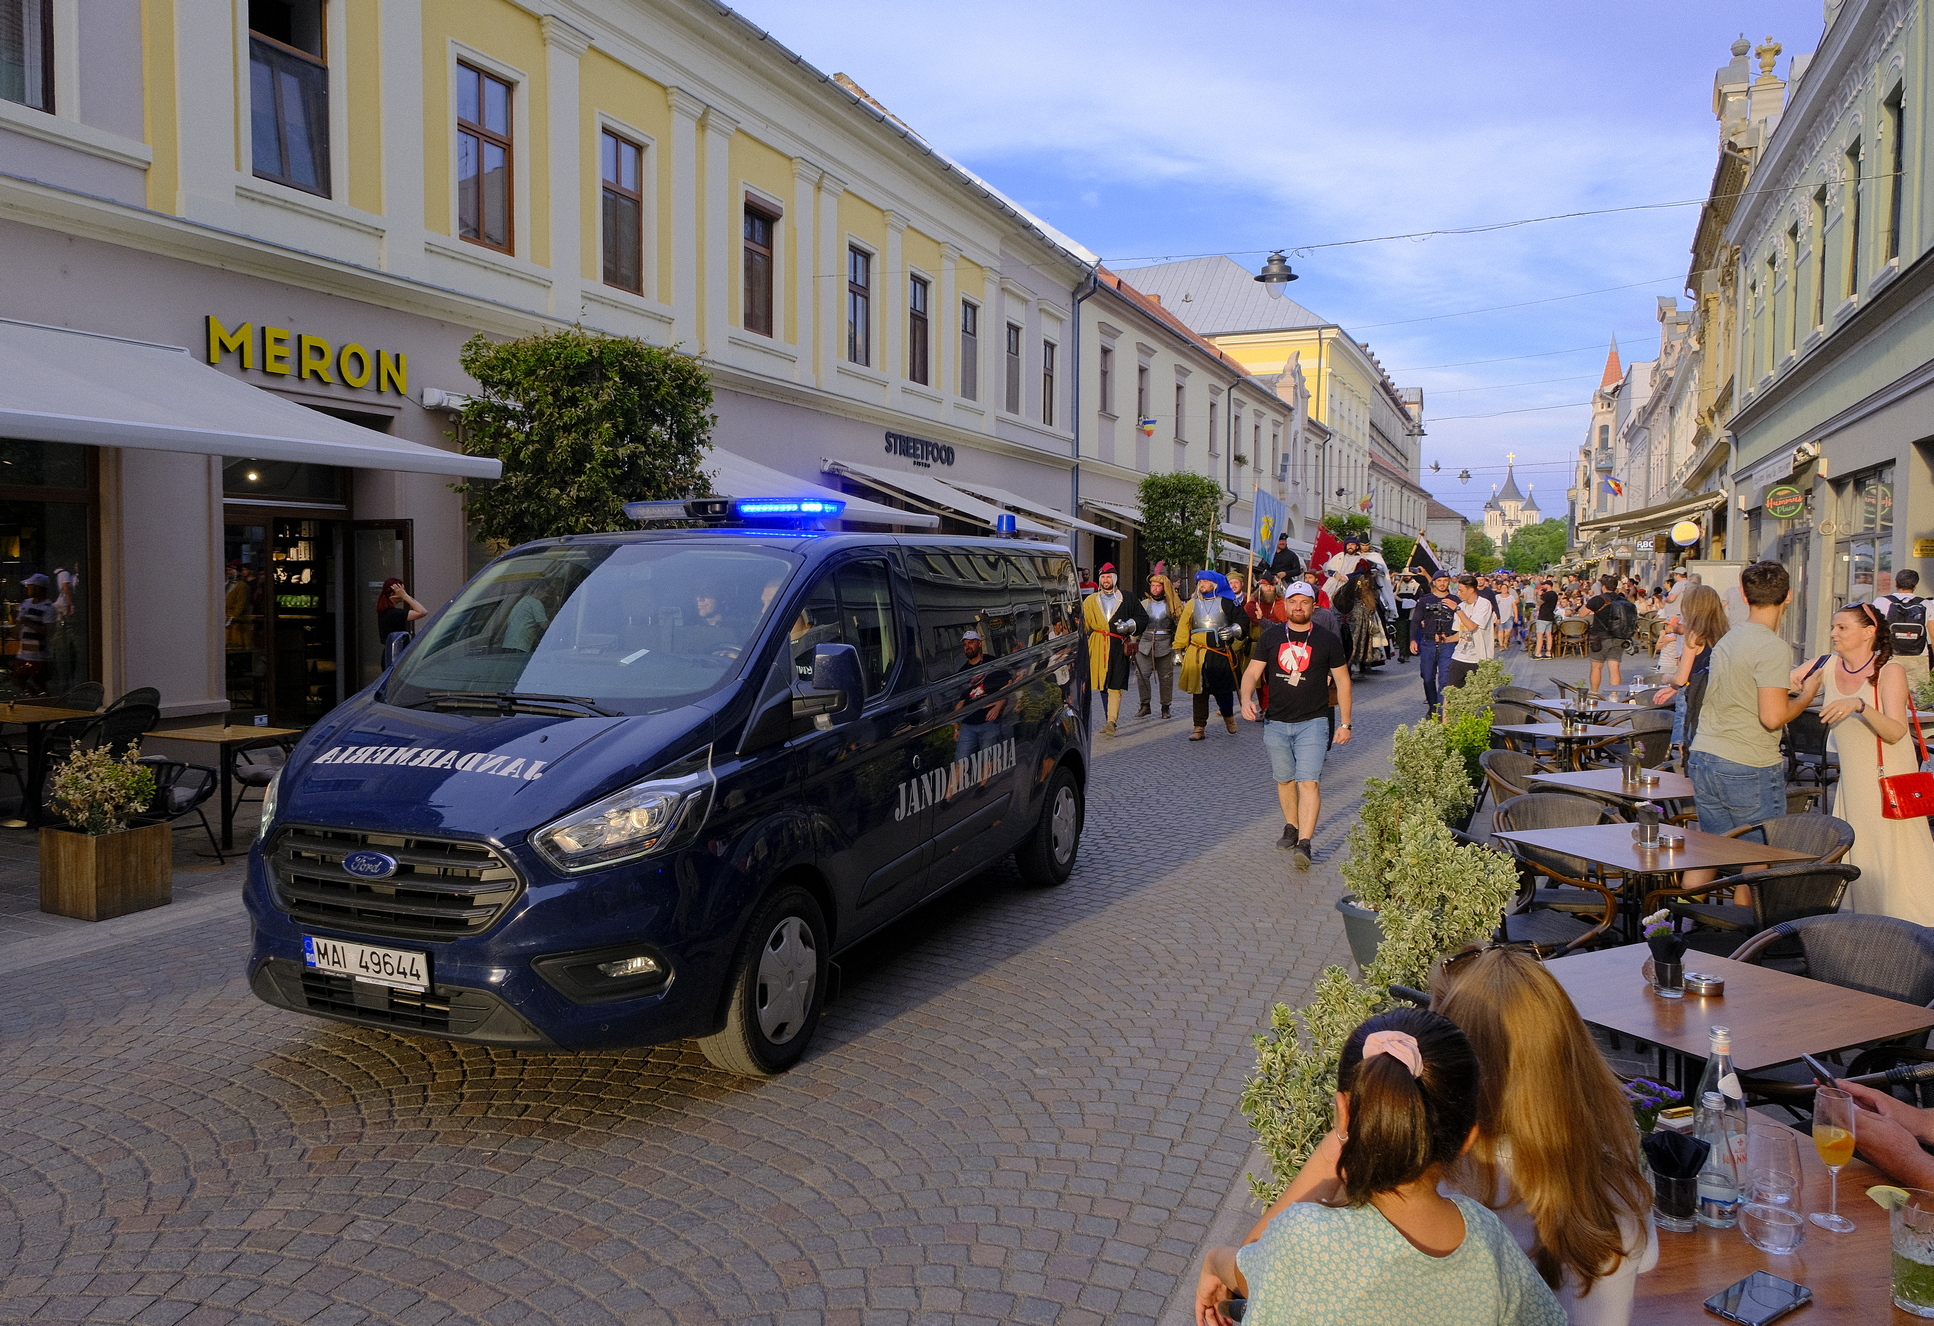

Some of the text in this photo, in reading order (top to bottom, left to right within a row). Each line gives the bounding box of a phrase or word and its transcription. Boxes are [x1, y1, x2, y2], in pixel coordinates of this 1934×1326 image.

[205, 315, 407, 395] MERON
[885, 431, 955, 466] STREETFOOD
[1765, 496, 1803, 508] Hummus
[1776, 505, 1795, 514] Place
[895, 737, 1016, 821] JANDARMERIA
[351, 856, 383, 873] Ford
[316, 941, 421, 981] MAI 49644
